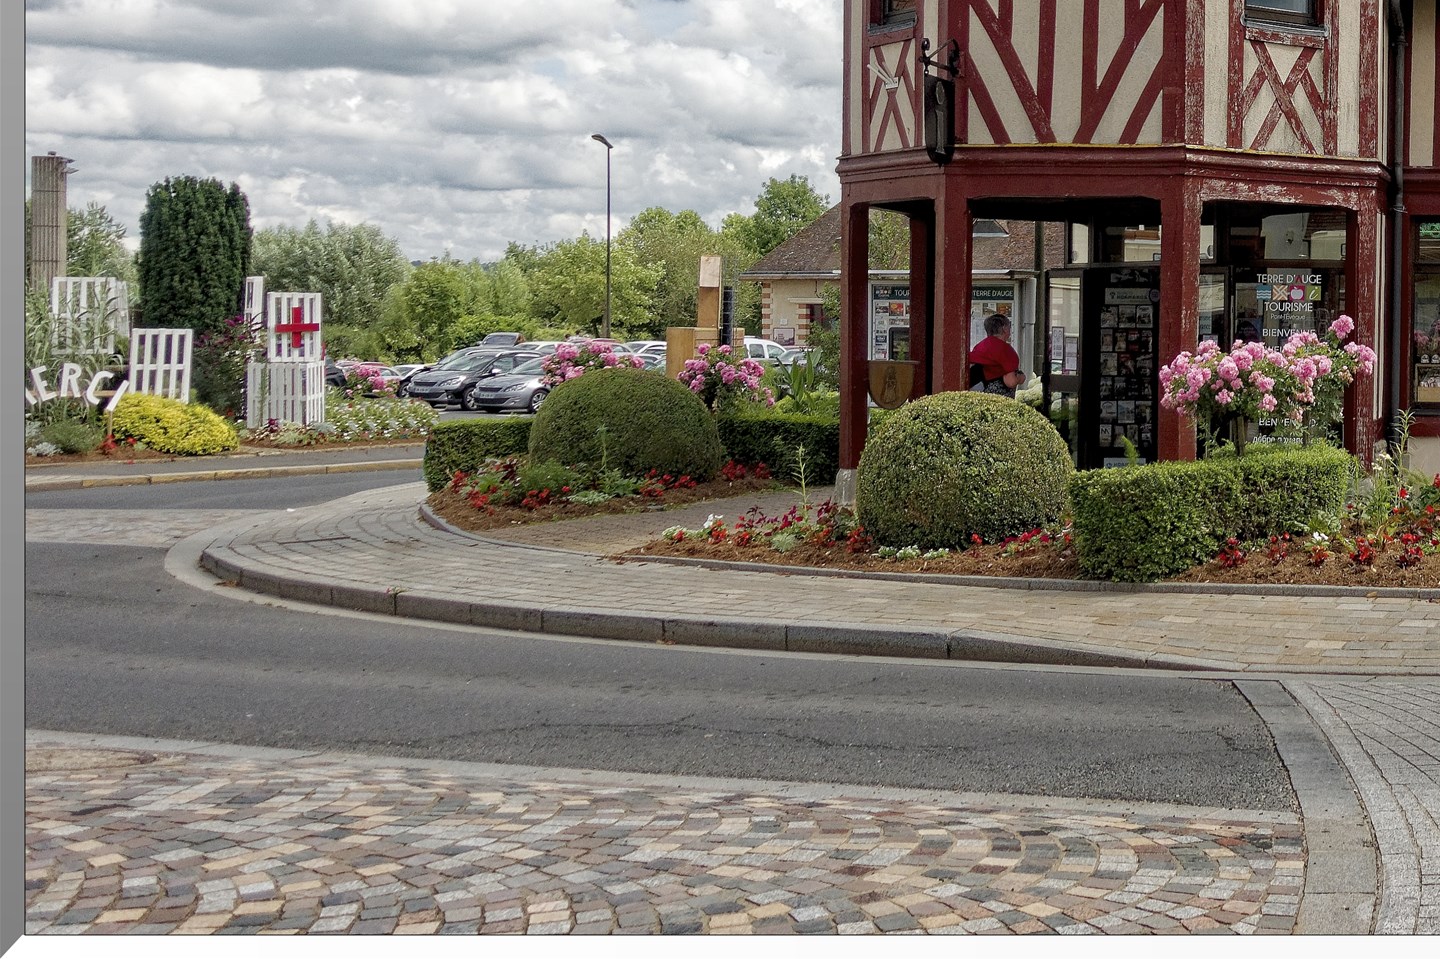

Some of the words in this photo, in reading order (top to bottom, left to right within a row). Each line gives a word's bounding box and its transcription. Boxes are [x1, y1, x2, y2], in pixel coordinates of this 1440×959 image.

[1257, 273, 1283, 283] TERRE
[1264, 302, 1313, 312] TOURISME
[25, 362, 129, 411] ERCI
